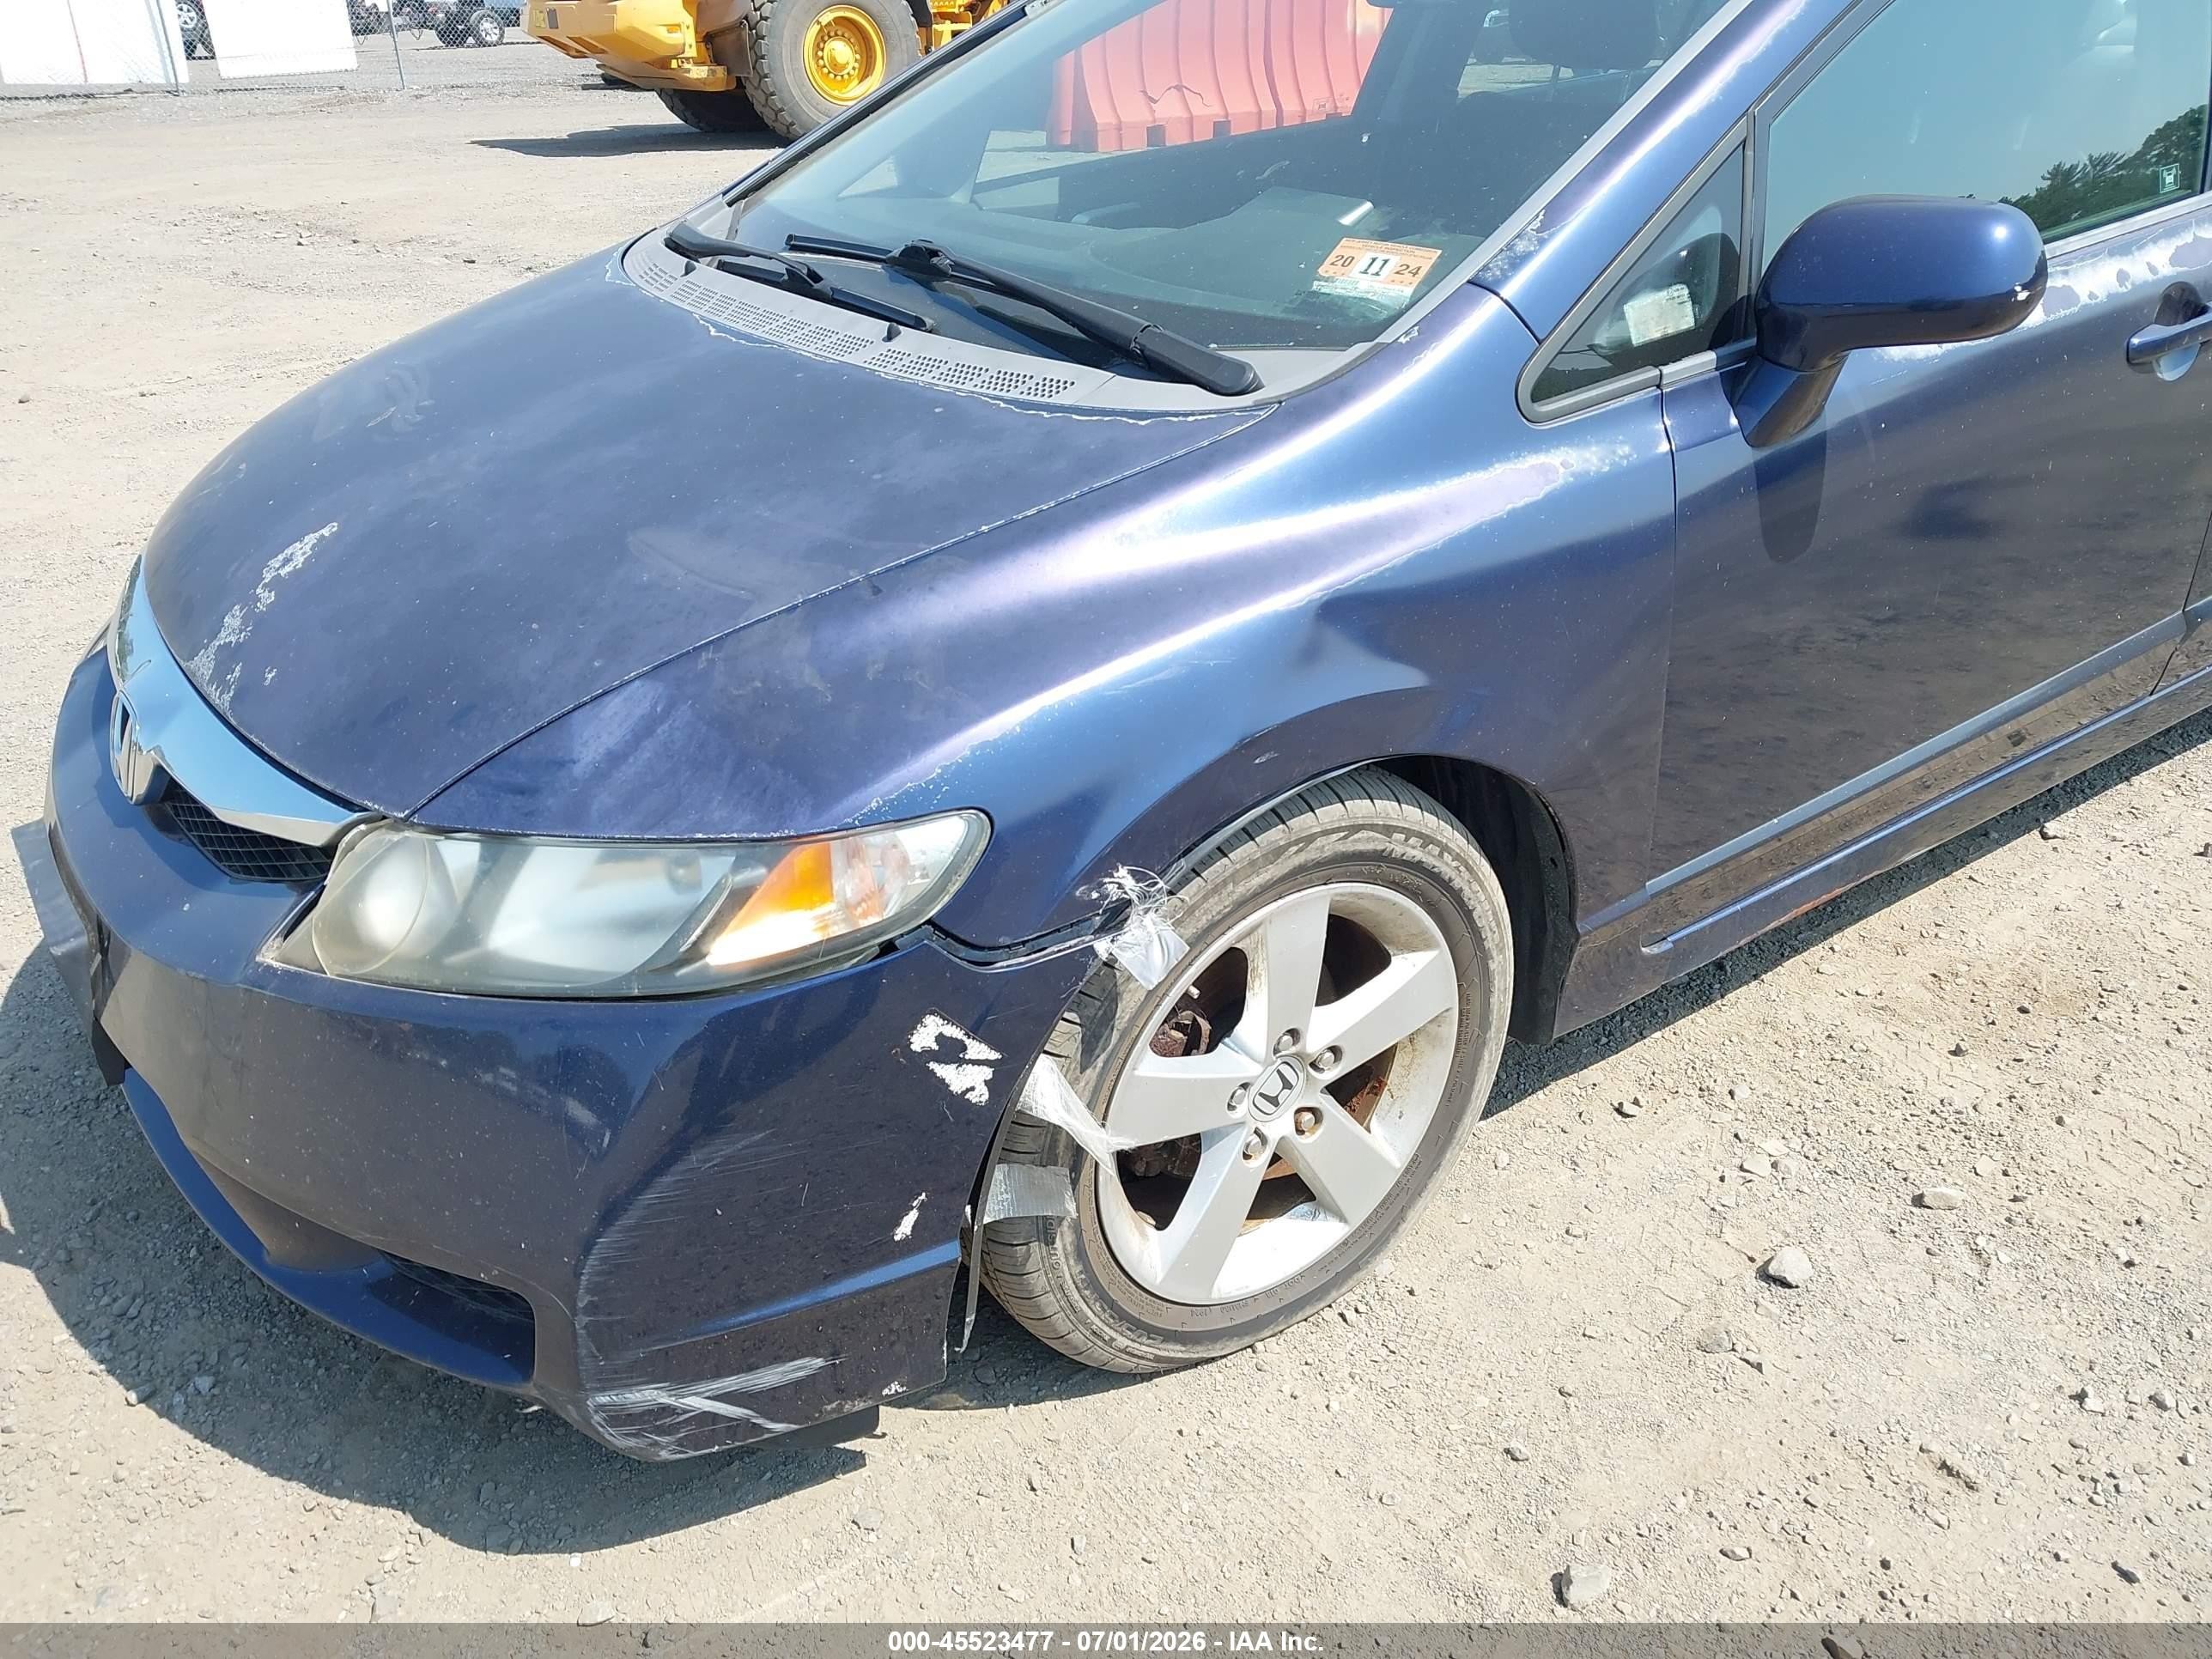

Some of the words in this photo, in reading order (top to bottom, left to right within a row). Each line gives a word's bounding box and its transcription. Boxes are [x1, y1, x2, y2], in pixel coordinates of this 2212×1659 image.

[1329, 254, 1355, 268] 20
[1358, 257, 1390, 276] 11
[1394, 263, 1423, 277] 24
